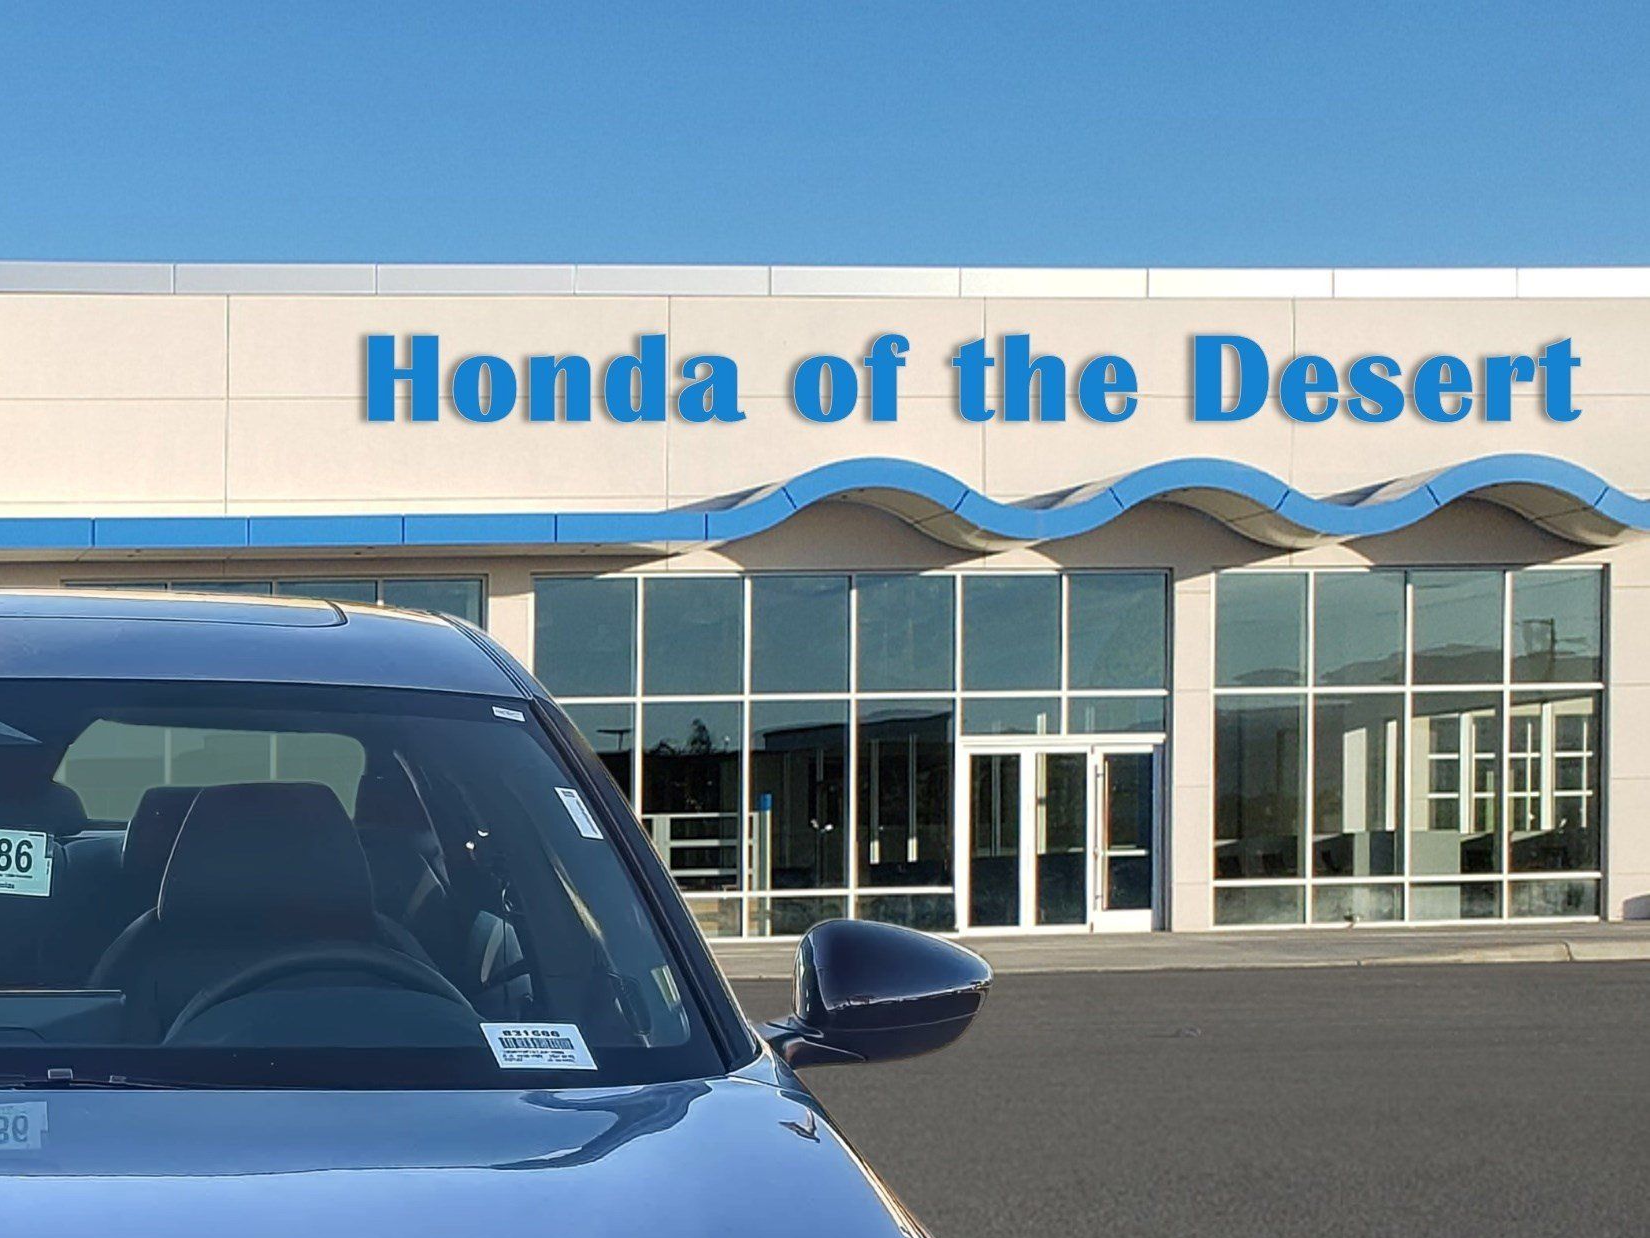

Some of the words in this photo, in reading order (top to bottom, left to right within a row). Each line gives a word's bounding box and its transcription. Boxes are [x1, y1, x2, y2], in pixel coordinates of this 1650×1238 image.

[366, 333, 748, 424] Honda
[792, 333, 911, 424] of
[951, 333, 1139, 424] the
[1193, 334, 1583, 424] Desert
